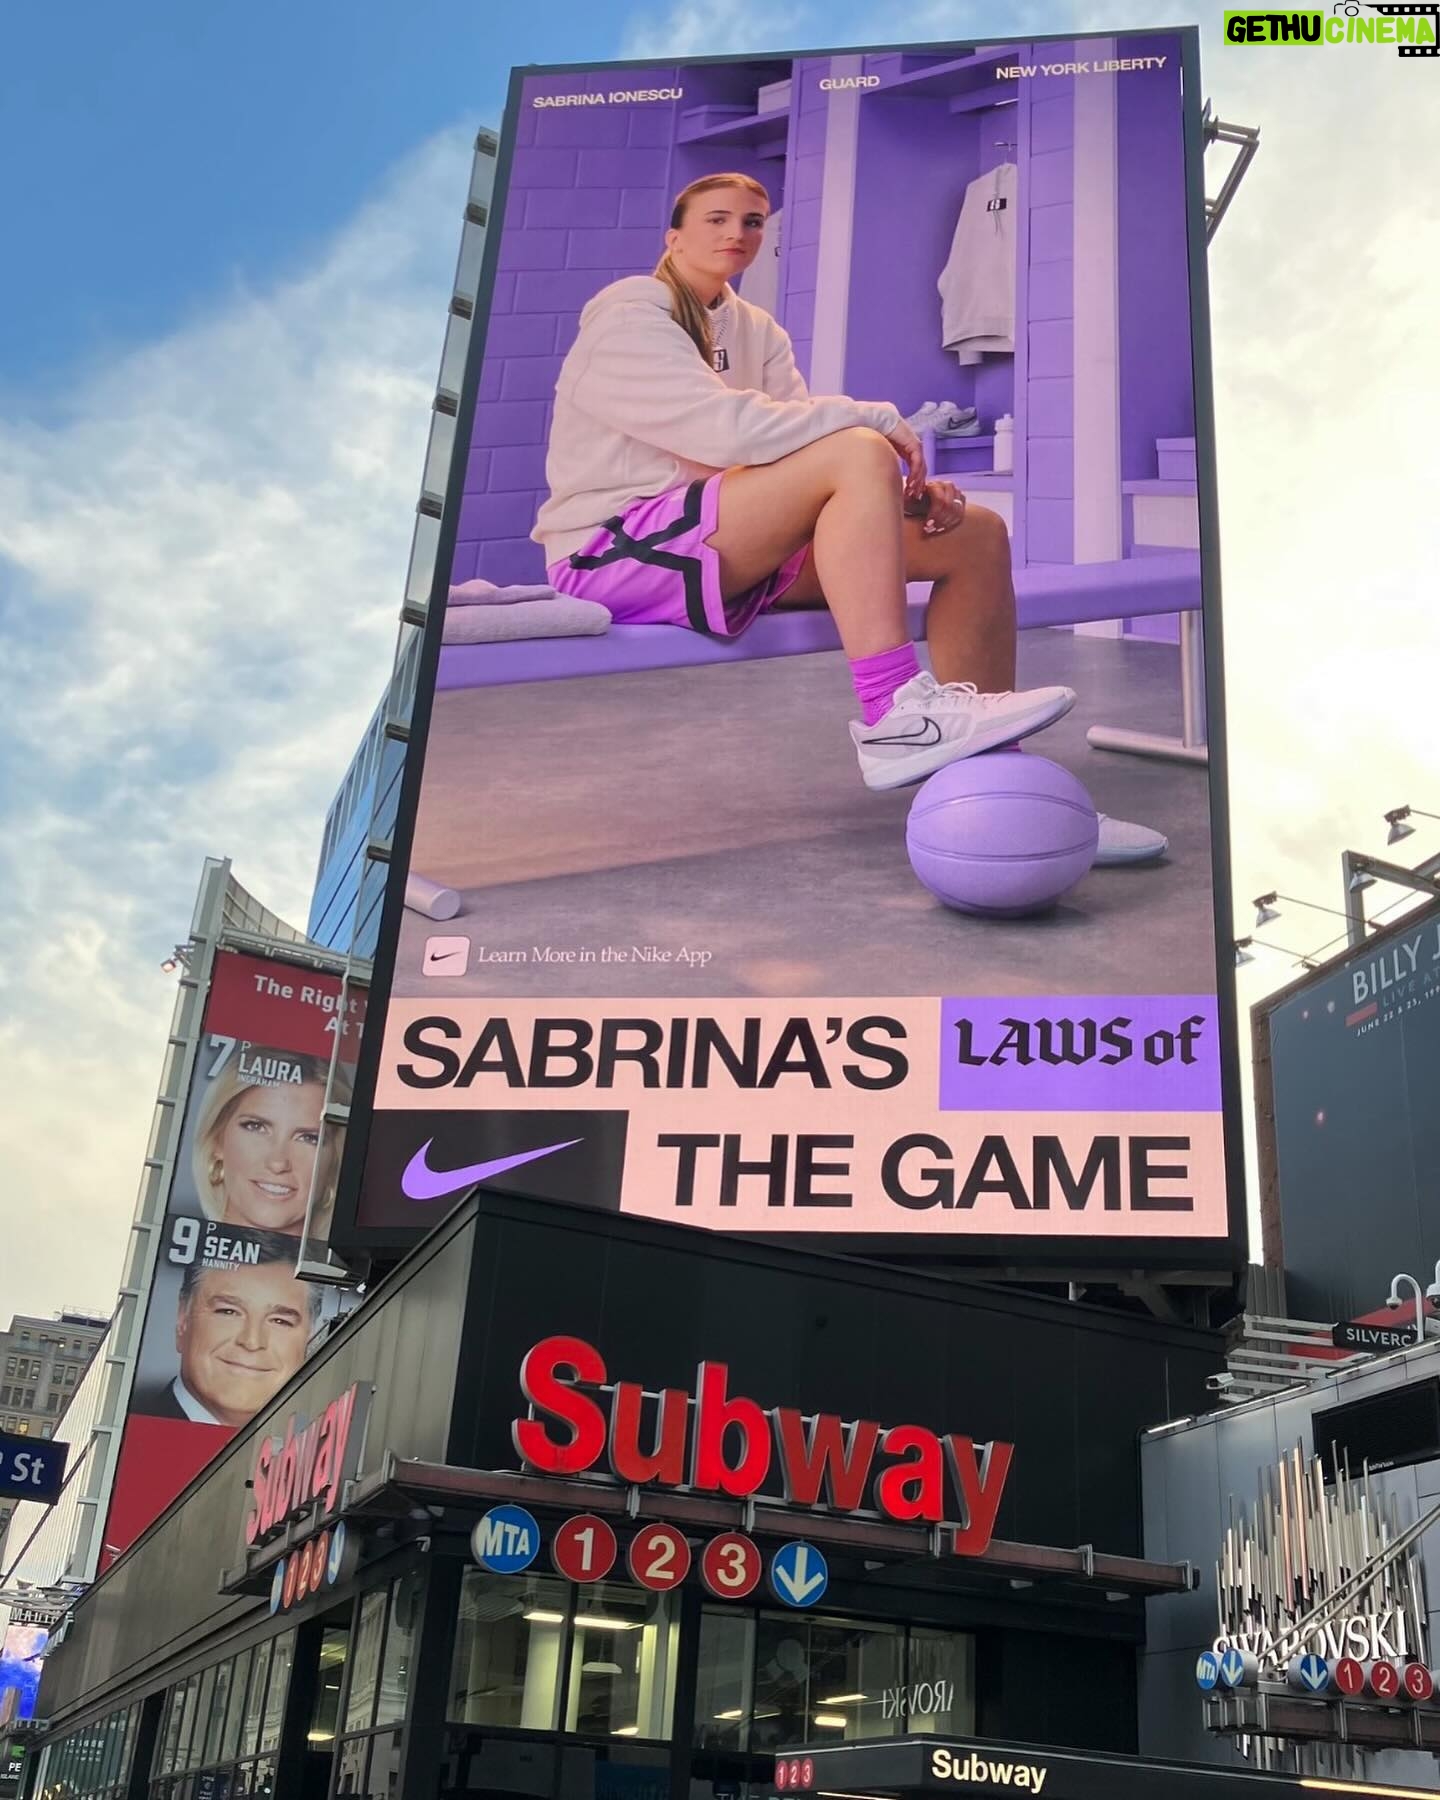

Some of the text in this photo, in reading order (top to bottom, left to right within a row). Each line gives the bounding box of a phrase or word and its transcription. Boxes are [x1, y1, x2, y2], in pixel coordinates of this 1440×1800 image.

[819, 75, 881, 91] GUARD
[996, 56, 1168, 79] NEW YORK LIBERTY
[532, 87, 683, 109] SABRINA IONESCU
[479, 946, 712, 967] Learn More in the Nike App
[1352, 934, 1423, 1005] BILLY
[254, 974, 294, 999] The
[1357, 1018, 1380, 1037] JUNE
[207, 1033, 237, 1078] 7
[238, 1053, 303, 1085] LAURA
[396, 1015, 1206, 1091] SABRINA'S LAWS of
[656, 1134, 1195, 1212] THE GAME
[168, 1216, 217, 1265] 9 P
[203, 1235, 260, 1265] SEAN
[202, 1257, 241, 1272] HANNITY
[511, 1335, 1015, 1556] Subway
[10, 1452, 45, 1485] St
[299, 1551, 311, 1590] 2
[313, 1541, 326, 1581] 3
[475, 1515, 747, 1587] MTA 1 2 3
[1343, 1662, 1424, 1694] 1 2 3
[778, 1764, 811, 1785] 1 2 3
[931, 1749, 1047, 1794] Subway
